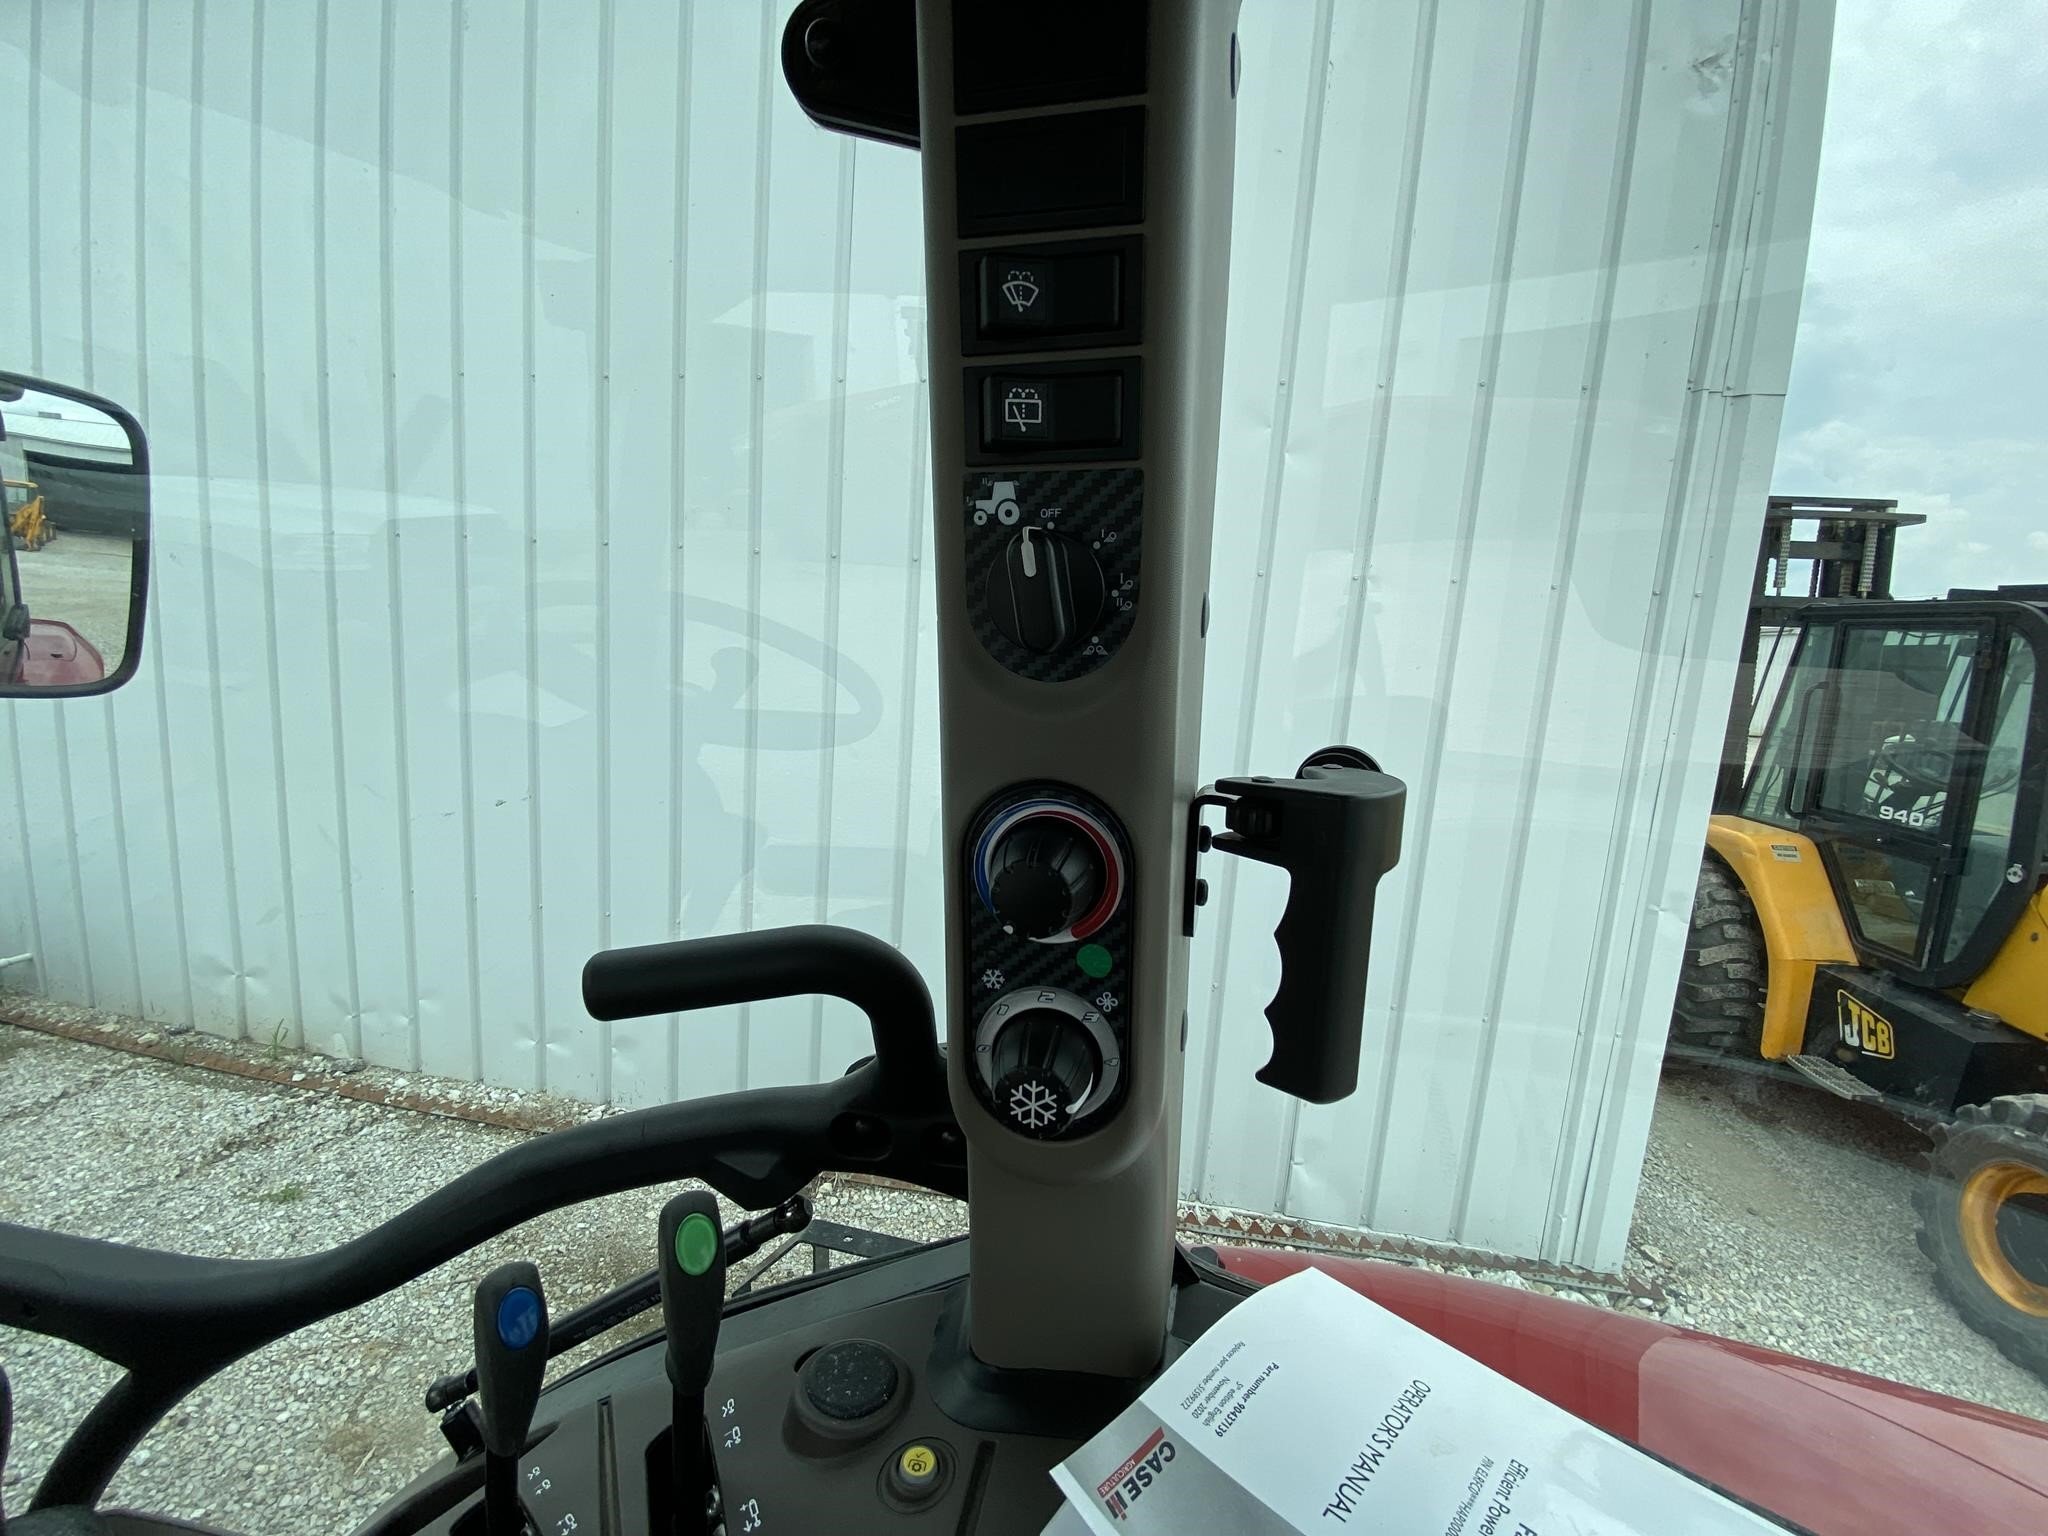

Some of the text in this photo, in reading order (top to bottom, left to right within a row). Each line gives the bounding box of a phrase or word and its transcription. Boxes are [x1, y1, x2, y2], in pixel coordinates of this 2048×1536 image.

[1040, 508, 1062, 518] OFF
[1879, 805, 1924, 827] 940
[997, 1004, 1009, 1016] 1
[1038, 991, 1056, 1003] 2
[1081, 1011, 1100, 1023] 3
[1844, 999, 1890, 1054] JCB
[1181, 1341, 1246, 1410] Replaces part number 51599272
[1191, 1376, 1230, 1419] November 2020
[1215, 1362, 1279, 1437] Part number 90437139
[1218, 1389, 1235, 1407] edition
[1202, 1407, 1222, 1426] English
[1322, 1379, 1431, 1523] OPERATOR'S MANUAL
[1481, 1456, 1494, 1471] PIN
[1099, 1459, 1136, 1495] AGRICULTURE
[1122, 1441, 1176, 1502] CASE
[1495, 1459, 1529, 1501] Efficient
